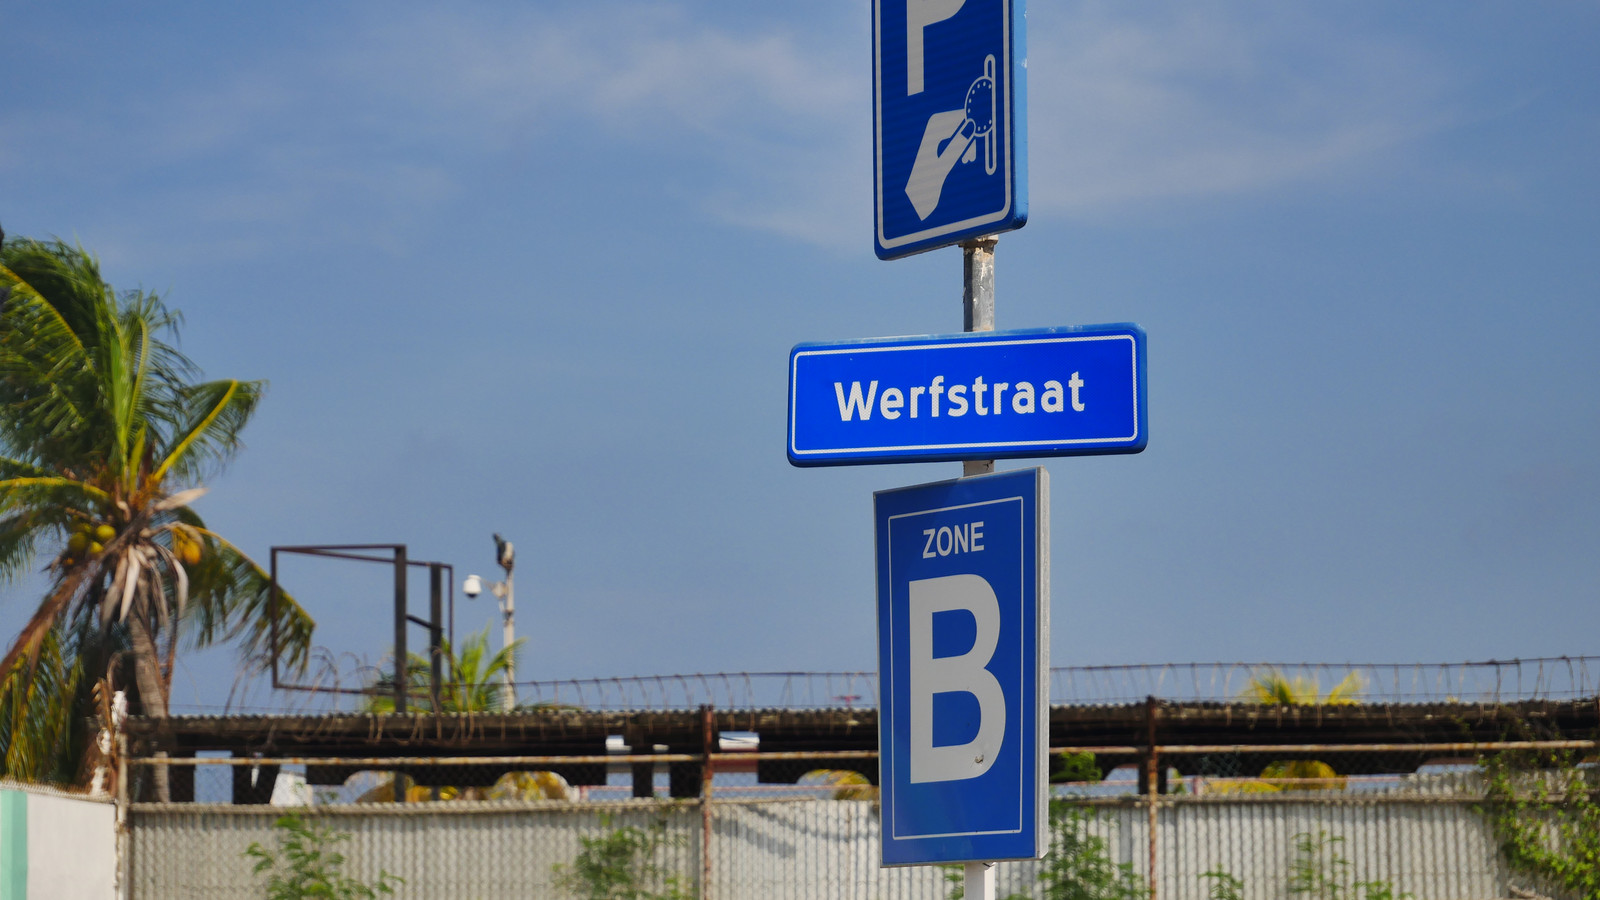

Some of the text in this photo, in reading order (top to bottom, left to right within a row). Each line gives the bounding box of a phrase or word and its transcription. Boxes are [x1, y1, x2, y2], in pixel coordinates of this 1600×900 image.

[833, 372, 1085, 422] Werfstraat
[922, 521, 985, 559] ZONE
[909, 574, 1006, 784] B
